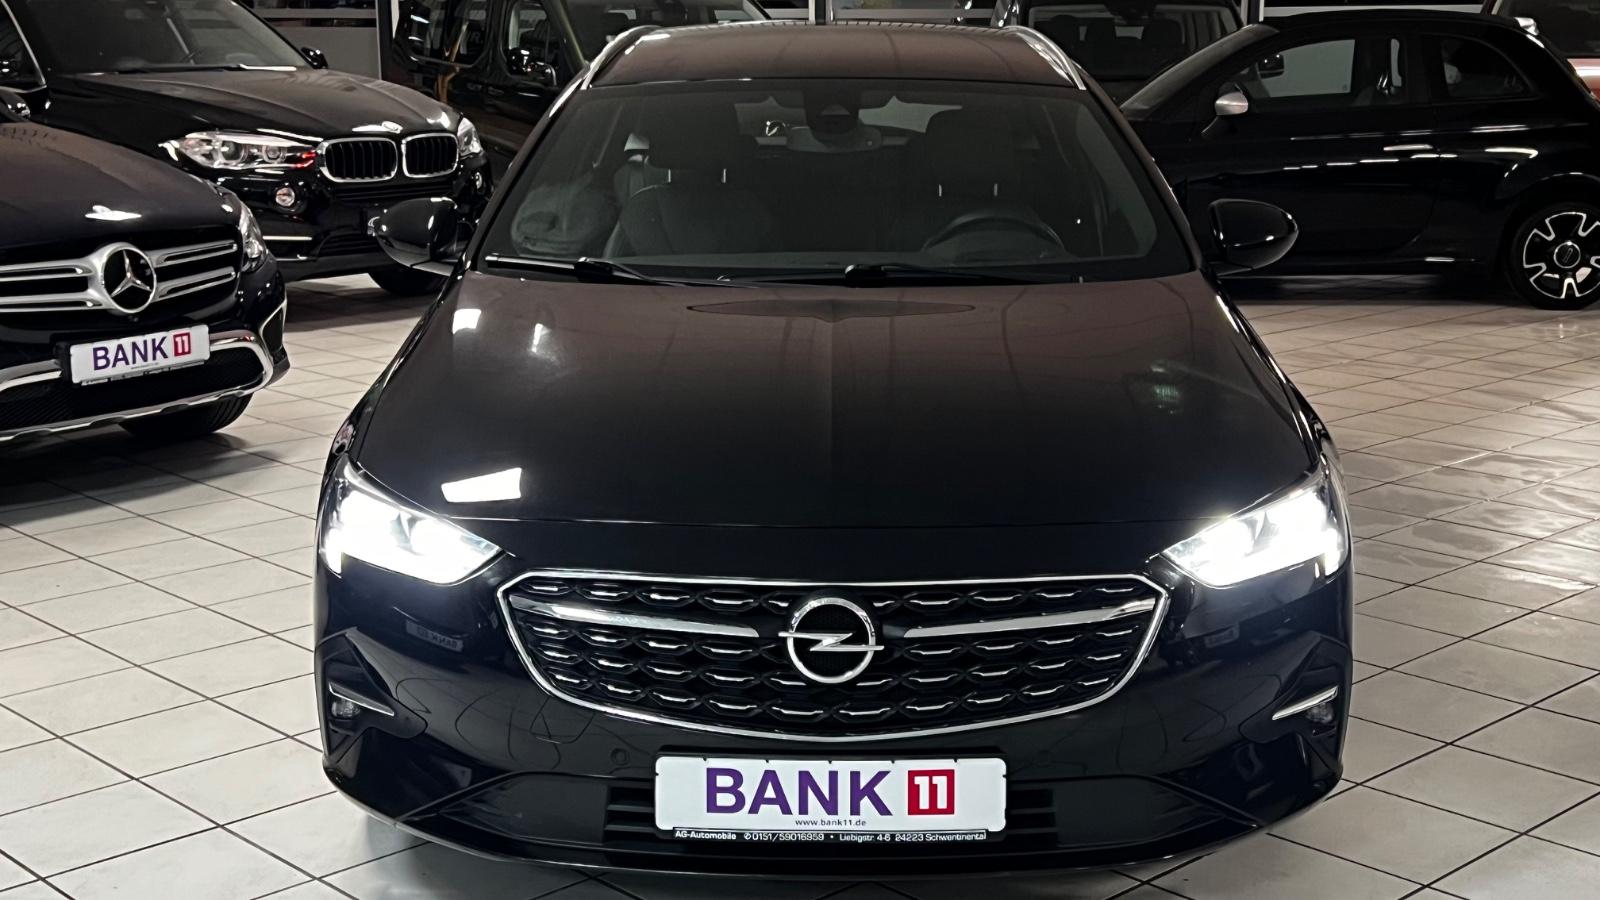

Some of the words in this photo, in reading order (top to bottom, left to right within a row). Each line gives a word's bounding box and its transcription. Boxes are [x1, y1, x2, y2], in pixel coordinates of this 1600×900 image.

[92, 336, 168, 370] BANK
[174, 334, 190, 355] 11
[706, 767, 893, 817] BANK
[912, 774, 950, 811] 11
[795, 818, 867, 827] www.bank11.de
[675, 830, 737, 840] AG-Automobile
[894, 834, 924, 842] 24223
